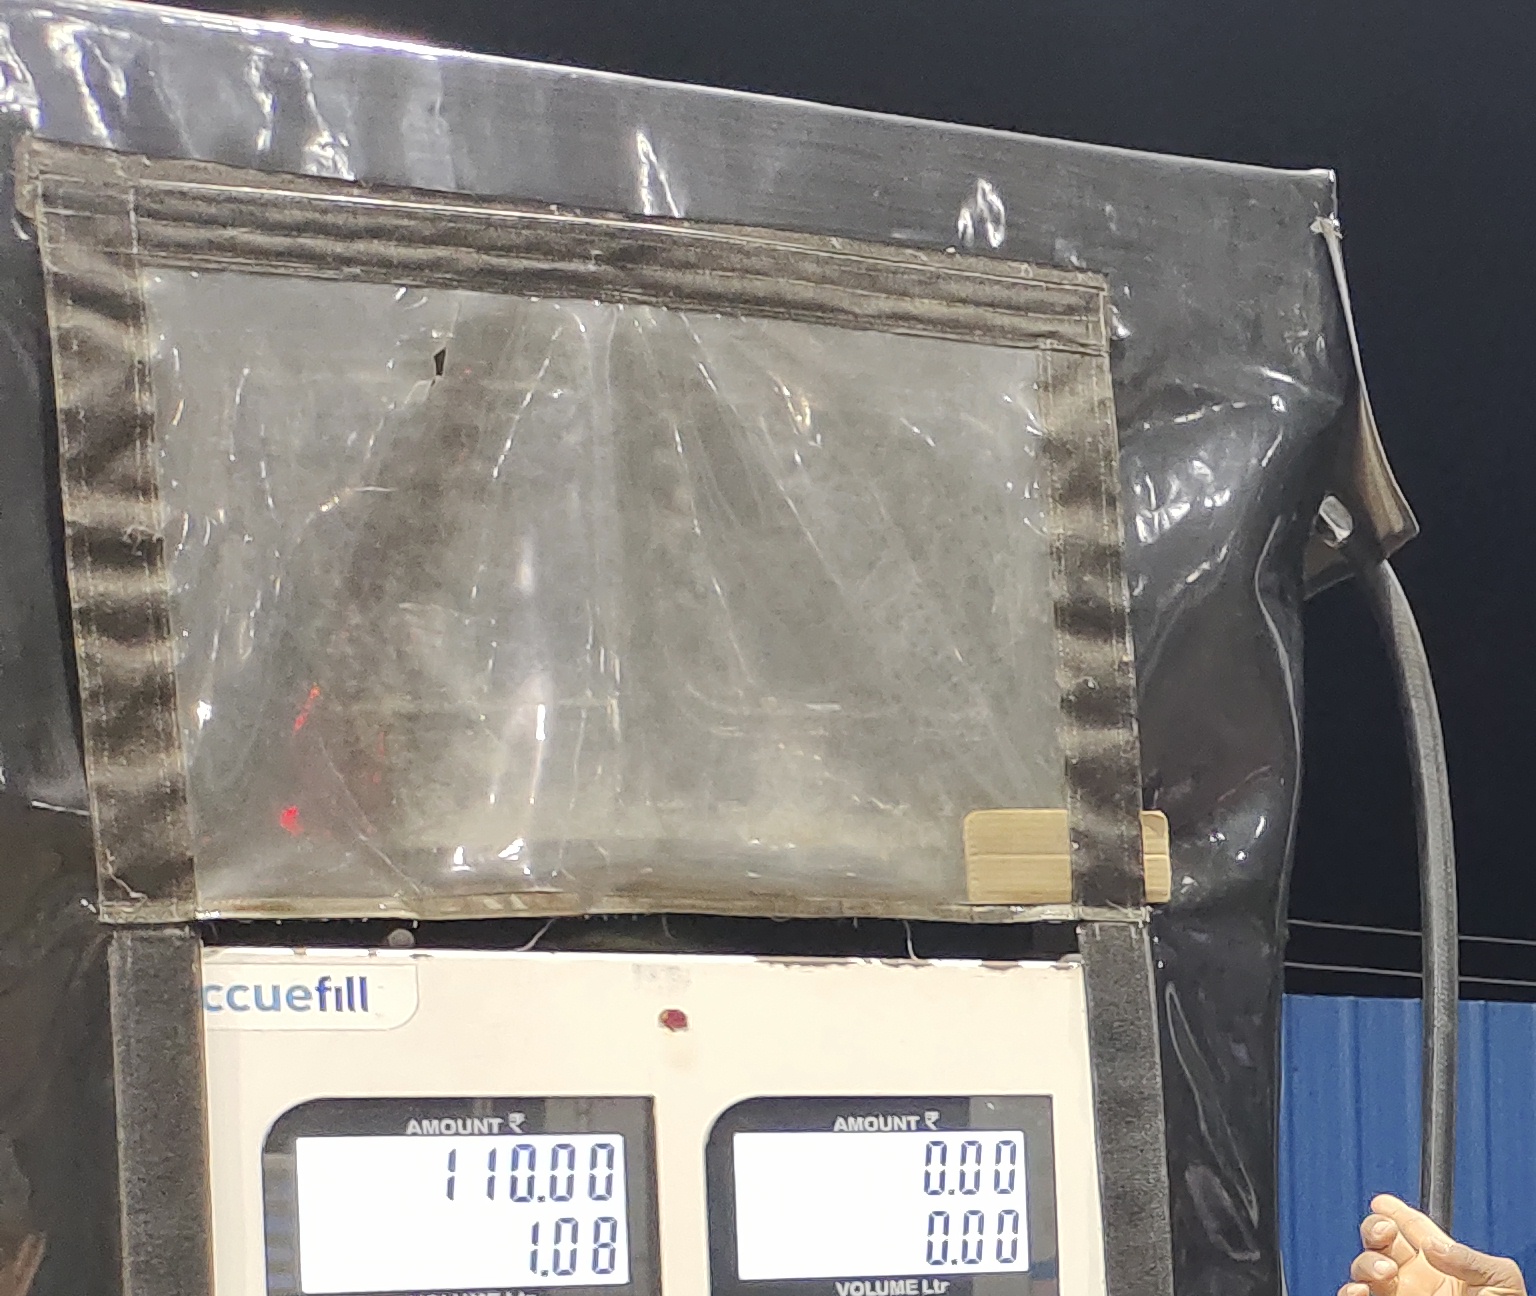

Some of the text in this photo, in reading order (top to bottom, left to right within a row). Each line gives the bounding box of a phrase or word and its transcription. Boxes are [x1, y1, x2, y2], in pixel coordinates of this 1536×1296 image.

[406, 1118, 504, 1135] AMOUNT
[833, 1115, 920, 1132] AMOUNT
[446, 1142, 615, 1202] 110.00
[924, 1139, 1017, 1195] 0.00
[530, 1216, 618, 1276] 1.08
[926, 1209, 1019, 1265] 0.00
[922, 1279, 950, 1295] Ltr
